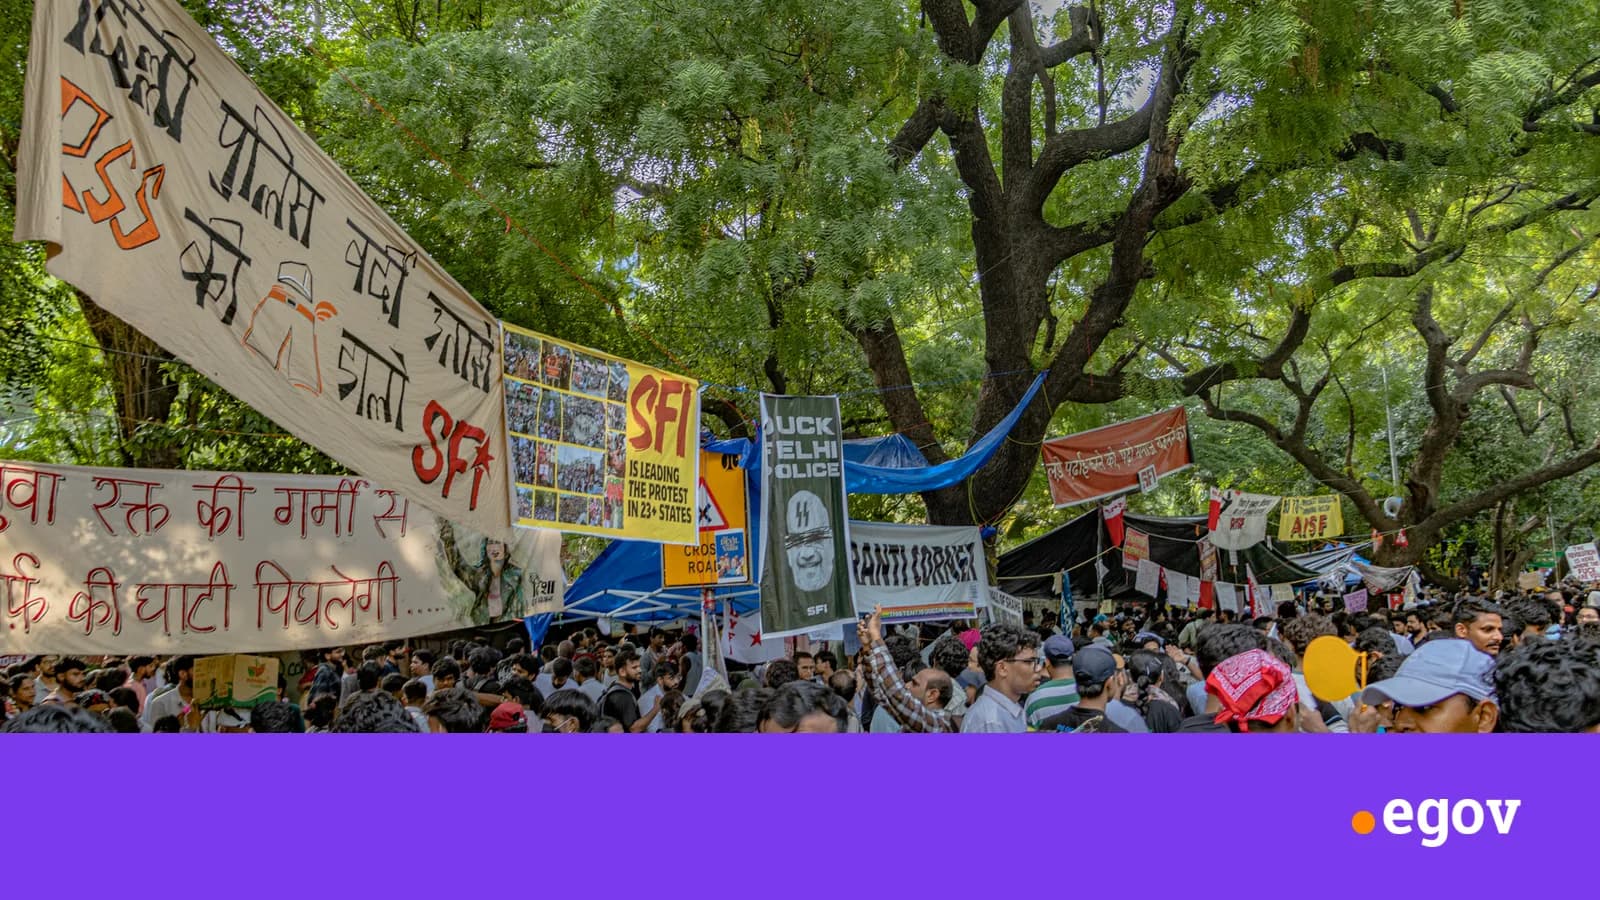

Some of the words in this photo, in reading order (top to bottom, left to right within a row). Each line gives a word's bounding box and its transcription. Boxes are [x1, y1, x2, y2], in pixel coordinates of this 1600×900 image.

[208, 99, 325, 248] पुलिस
[629, 374, 691, 458] SFI
[412, 400, 487, 511] SFI
[629, 460, 638, 478] IS
[640, 461, 680, 484] LEADING
[628, 479, 647, 499] THE
[648, 483, 688, 504] PROTEST
[192, 474, 257, 541] की
[274, 478, 370, 539] गर्मी
[627, 500, 639, 518] IN
[640, 501, 657, 519] 23+
[659, 503, 692, 524] STATES
[1290, 514, 1328, 539] AISF
[684, 544, 716, 557] CROS
[67, 567, 122, 635] की
[136, 560, 237, 636] घाटी
[253, 560, 401, 630] पिघलेगी
[806, 603, 828, 616] SFI
